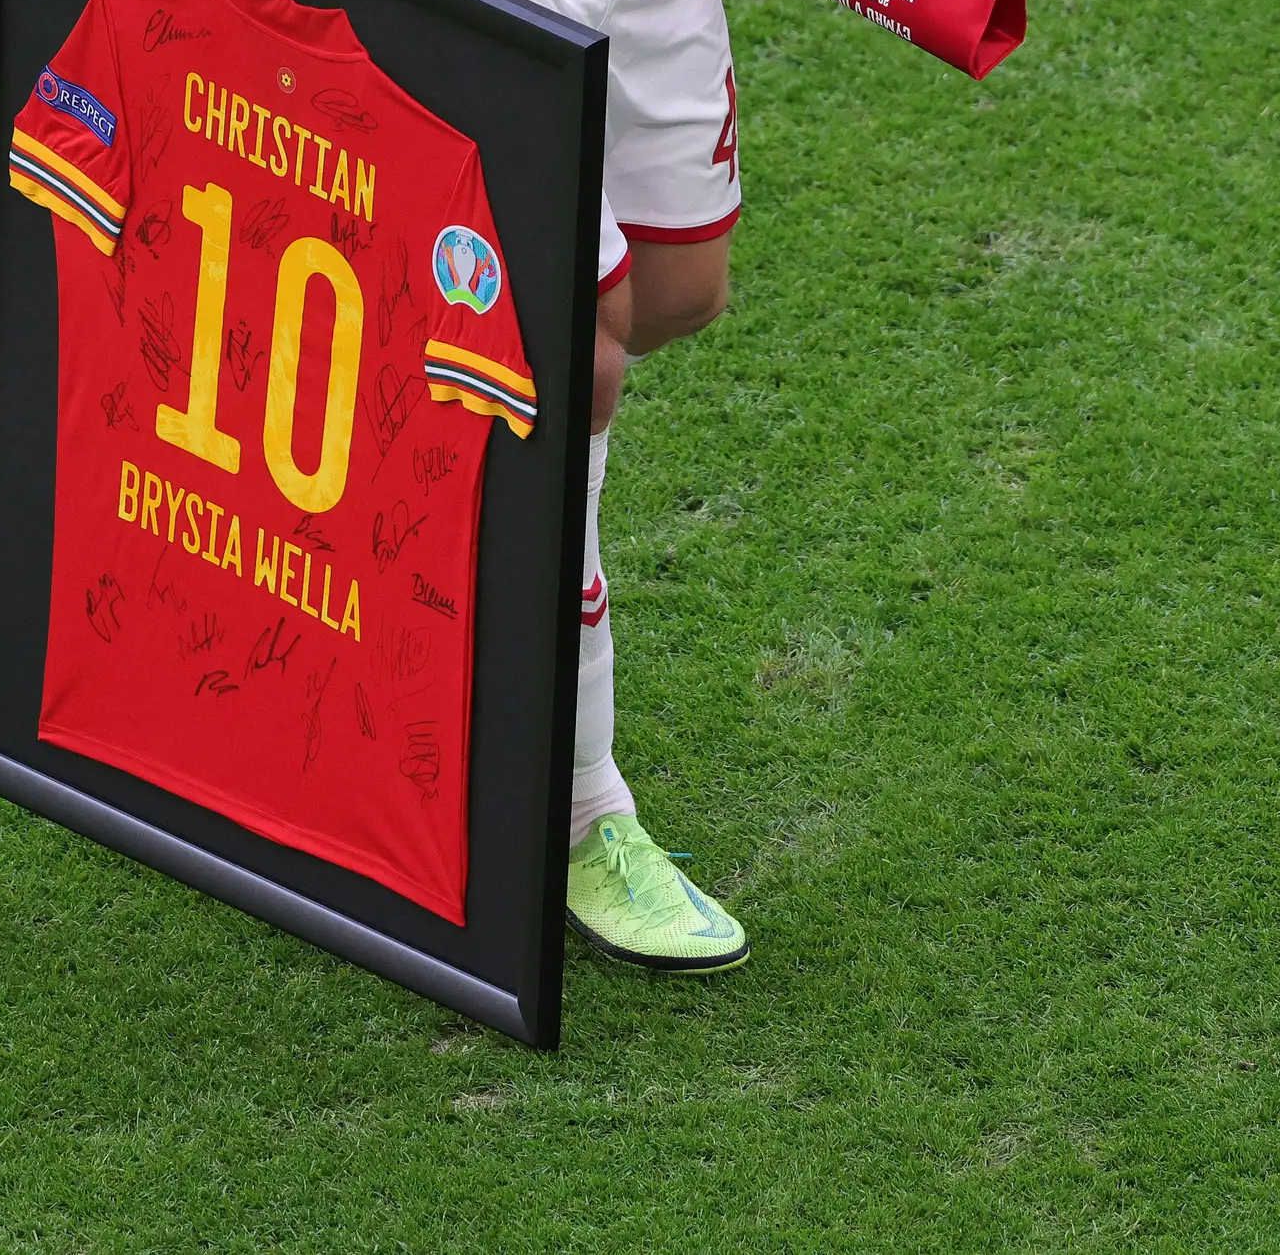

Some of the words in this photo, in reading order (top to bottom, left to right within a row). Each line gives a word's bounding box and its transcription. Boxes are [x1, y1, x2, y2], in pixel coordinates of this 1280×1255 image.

[866, 6, 912, 42] CYMRU
[60, 89, 115, 137] RESPECT
[183, 71, 377, 223] CHRISTIAN
[711, 65, 737, 185] 4
[154, 181, 365, 514] 10
[117, 459, 243, 578] BRYSIA
[253, 527, 361, 643] WELLA
[602, 827, 616, 842] NIKE
